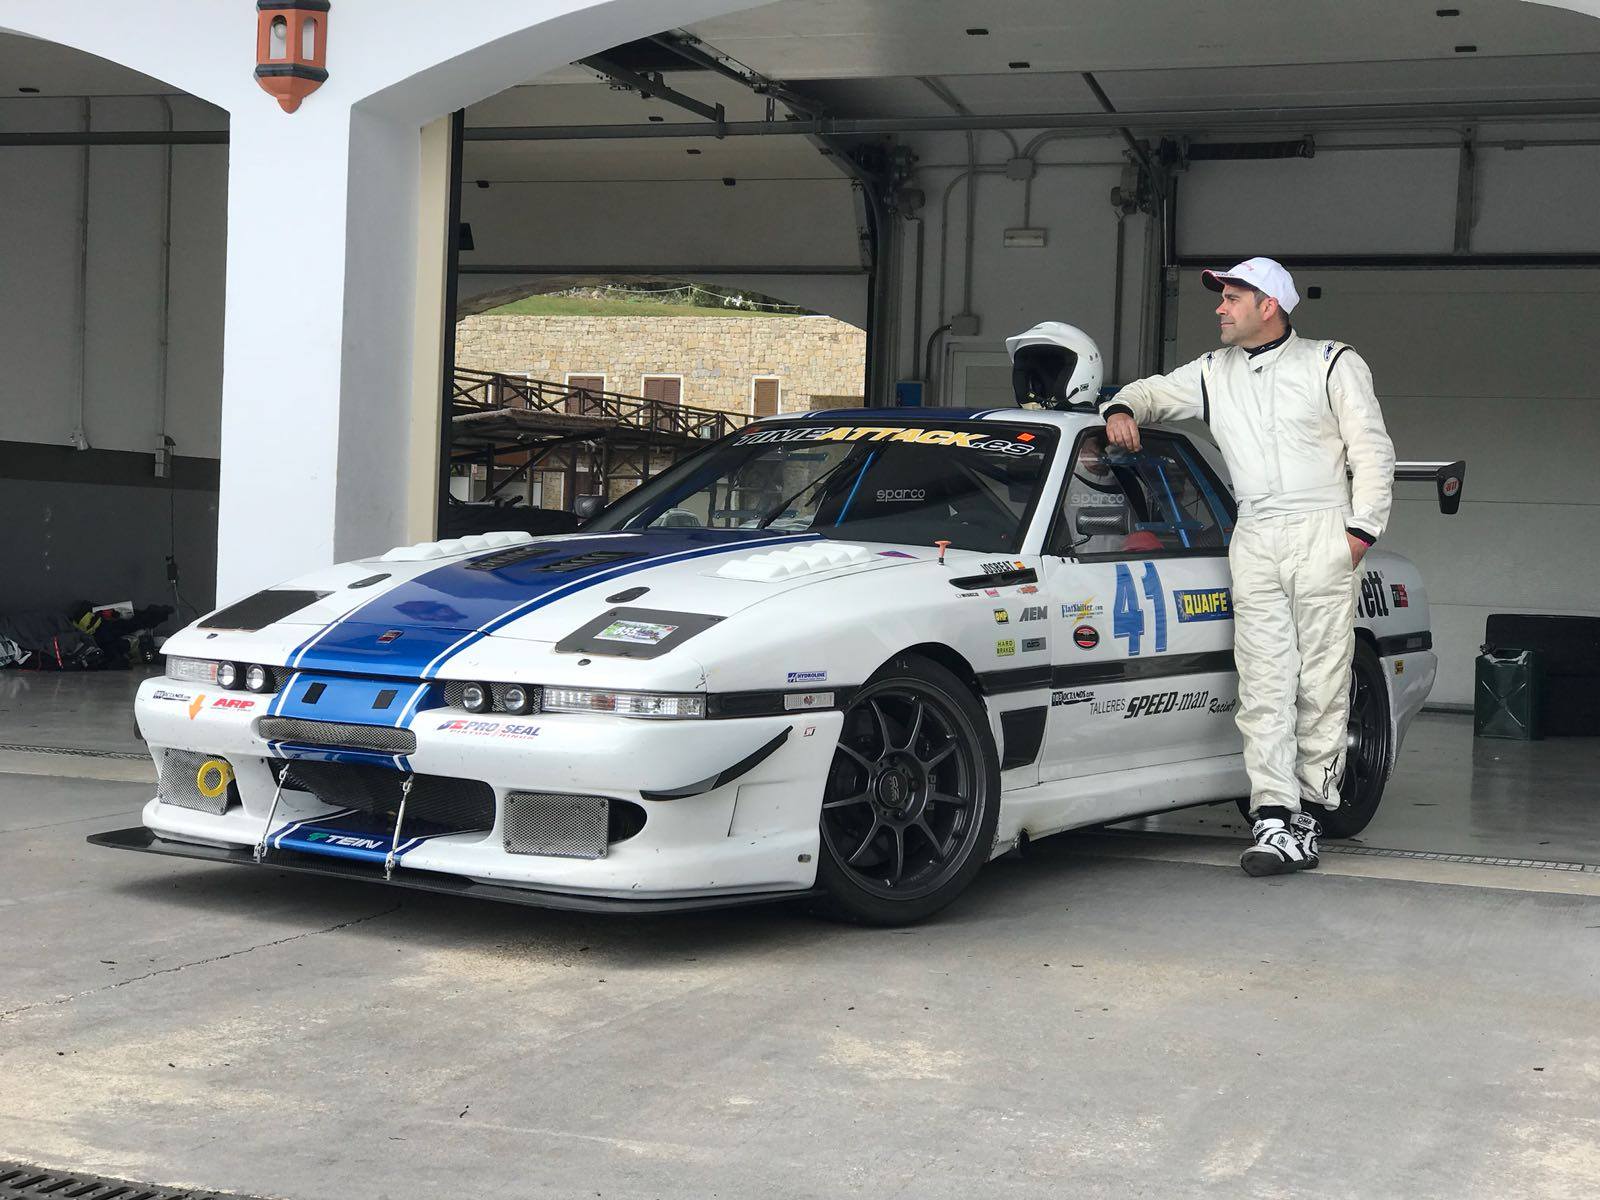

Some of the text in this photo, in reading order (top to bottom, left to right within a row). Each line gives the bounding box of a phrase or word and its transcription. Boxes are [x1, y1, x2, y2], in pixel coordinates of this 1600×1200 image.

[876, 488, 926, 503] sparco
[1071, 493, 1125, 507] sparco
[980, 560, 1015, 575] JOSBEAT
[1113, 561, 1168, 656] 41
[1183, 592, 1228, 616] QUAIFE
[1019, 605, 1048, 622] AEM
[212, 698, 255, 709] ARP
[1090, 698, 1126, 715] TALLERES
[1123, 690, 1209, 719] SPEED-man
[463, 721, 500, 732] PRO
[501, 724, 541, 737] SEAL
[325, 834, 384, 850] TEIN
